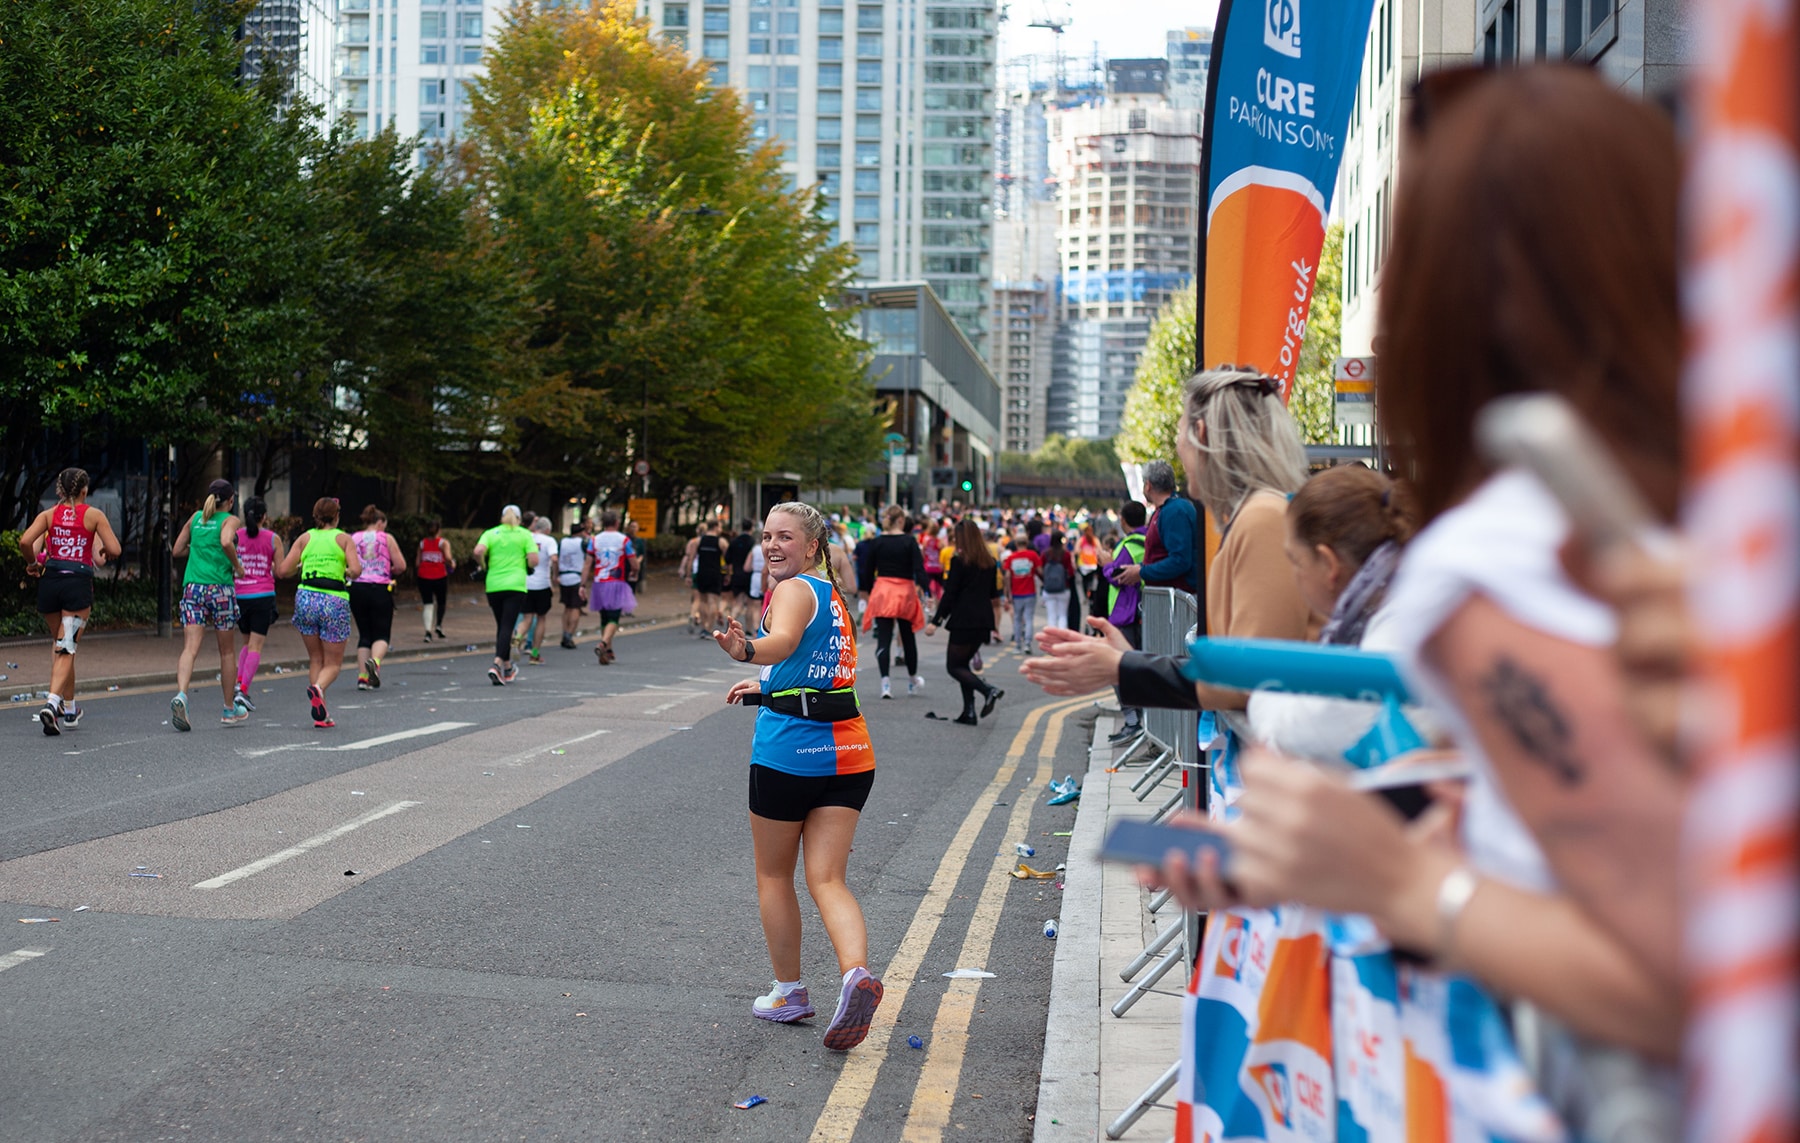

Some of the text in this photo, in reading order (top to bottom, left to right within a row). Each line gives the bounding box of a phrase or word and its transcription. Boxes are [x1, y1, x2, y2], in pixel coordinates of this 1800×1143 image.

[1257, 67, 1315, 119] CURE
[1230, 95, 1334, 159] PARKINSON'S
[54, 526, 71, 536] The
[52, 534, 87, 546] race is
[58, 545, 84, 557] on
[829, 634, 851, 650] CURE
[807, 663, 826, 679] FOR
[796, 742, 869, 755] cureparkinsons.org.uk
